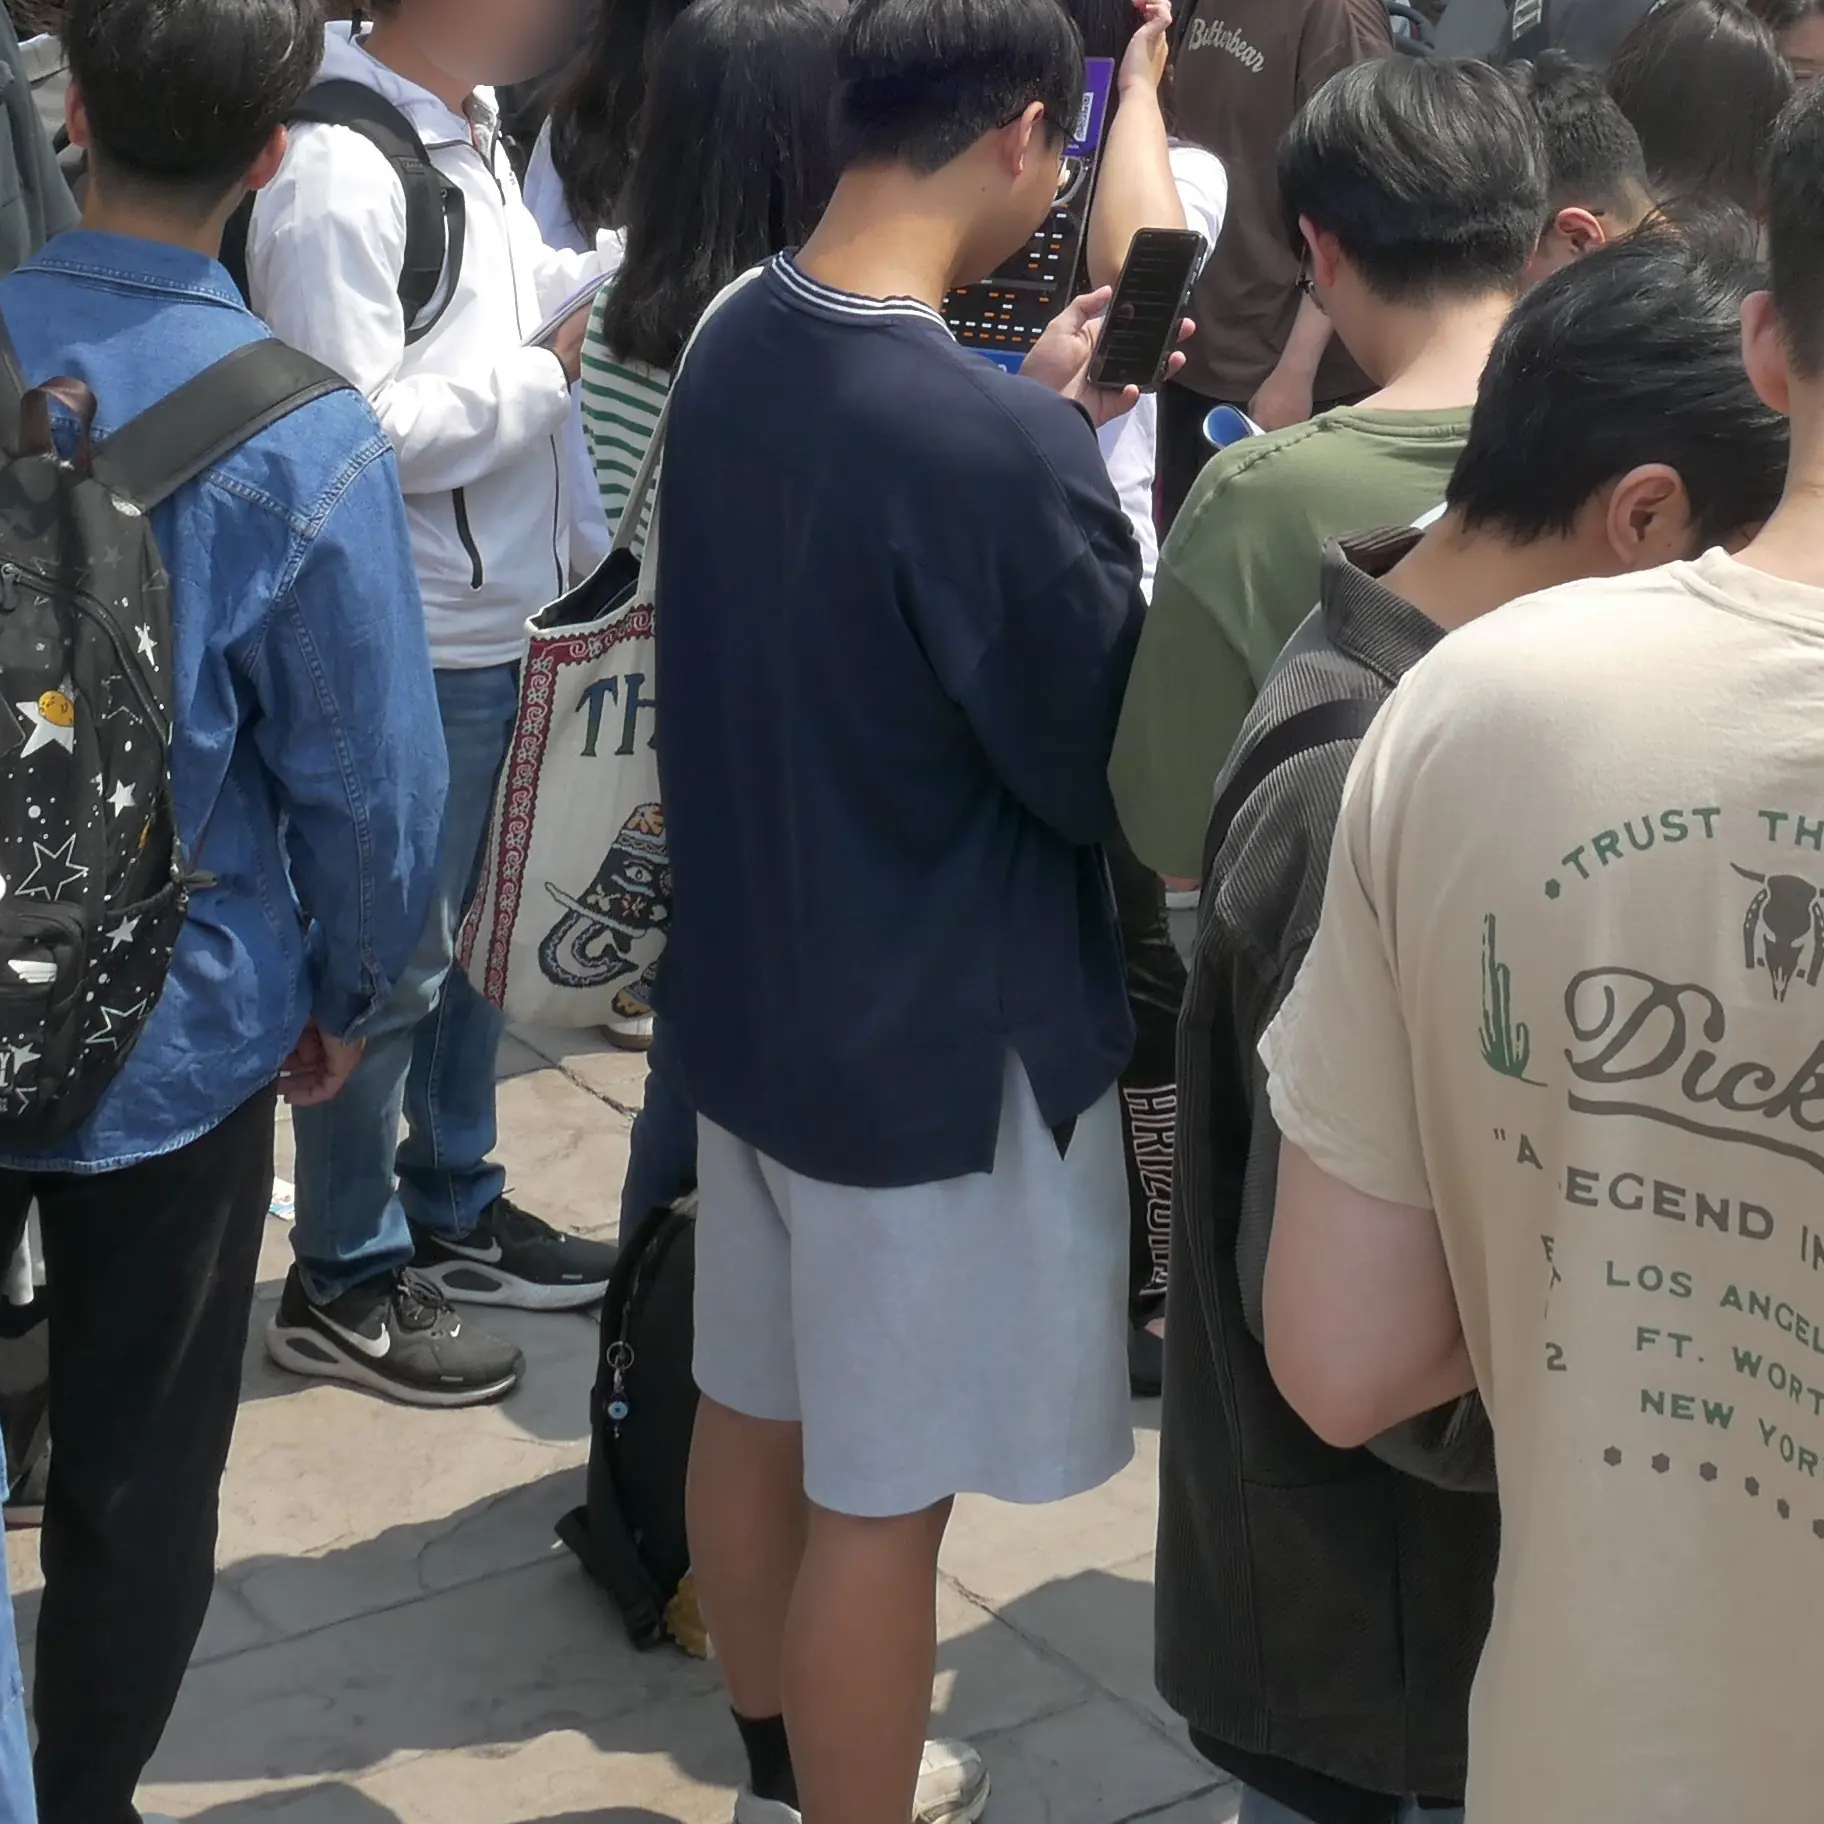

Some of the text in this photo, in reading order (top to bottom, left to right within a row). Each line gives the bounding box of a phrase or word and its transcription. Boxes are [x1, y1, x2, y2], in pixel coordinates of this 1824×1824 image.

[1560, 805, 1722, 883] TRUST
[1556, 1164, 1775, 1243] EGEND
[1605, 1259, 1694, 1301] LOS
[1635, 1325, 1707, 1366] FT.
[1640, 1387, 1734, 1432] NEW
